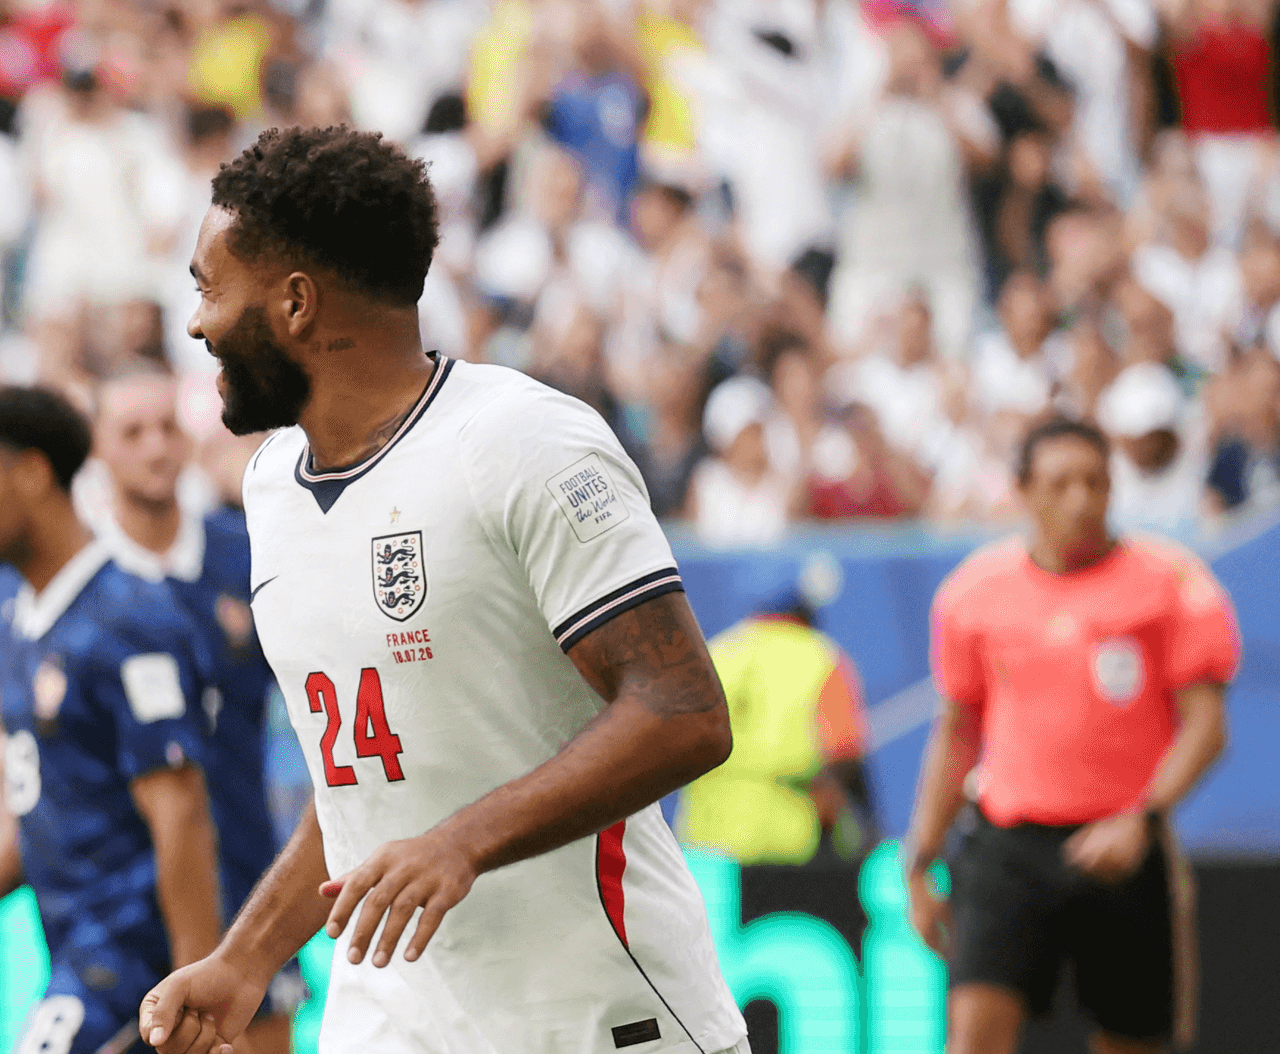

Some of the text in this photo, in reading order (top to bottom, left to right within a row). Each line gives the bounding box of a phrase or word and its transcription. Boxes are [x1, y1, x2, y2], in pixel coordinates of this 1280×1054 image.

[559, 465, 599, 494] FOOTBALL
[566, 475, 608, 508] UNITES
[574, 489, 617, 523] the World
[594, 511, 613, 524] FIFA
[386, 629, 431, 647] FRANCE
[304, 667, 406, 788] 24
